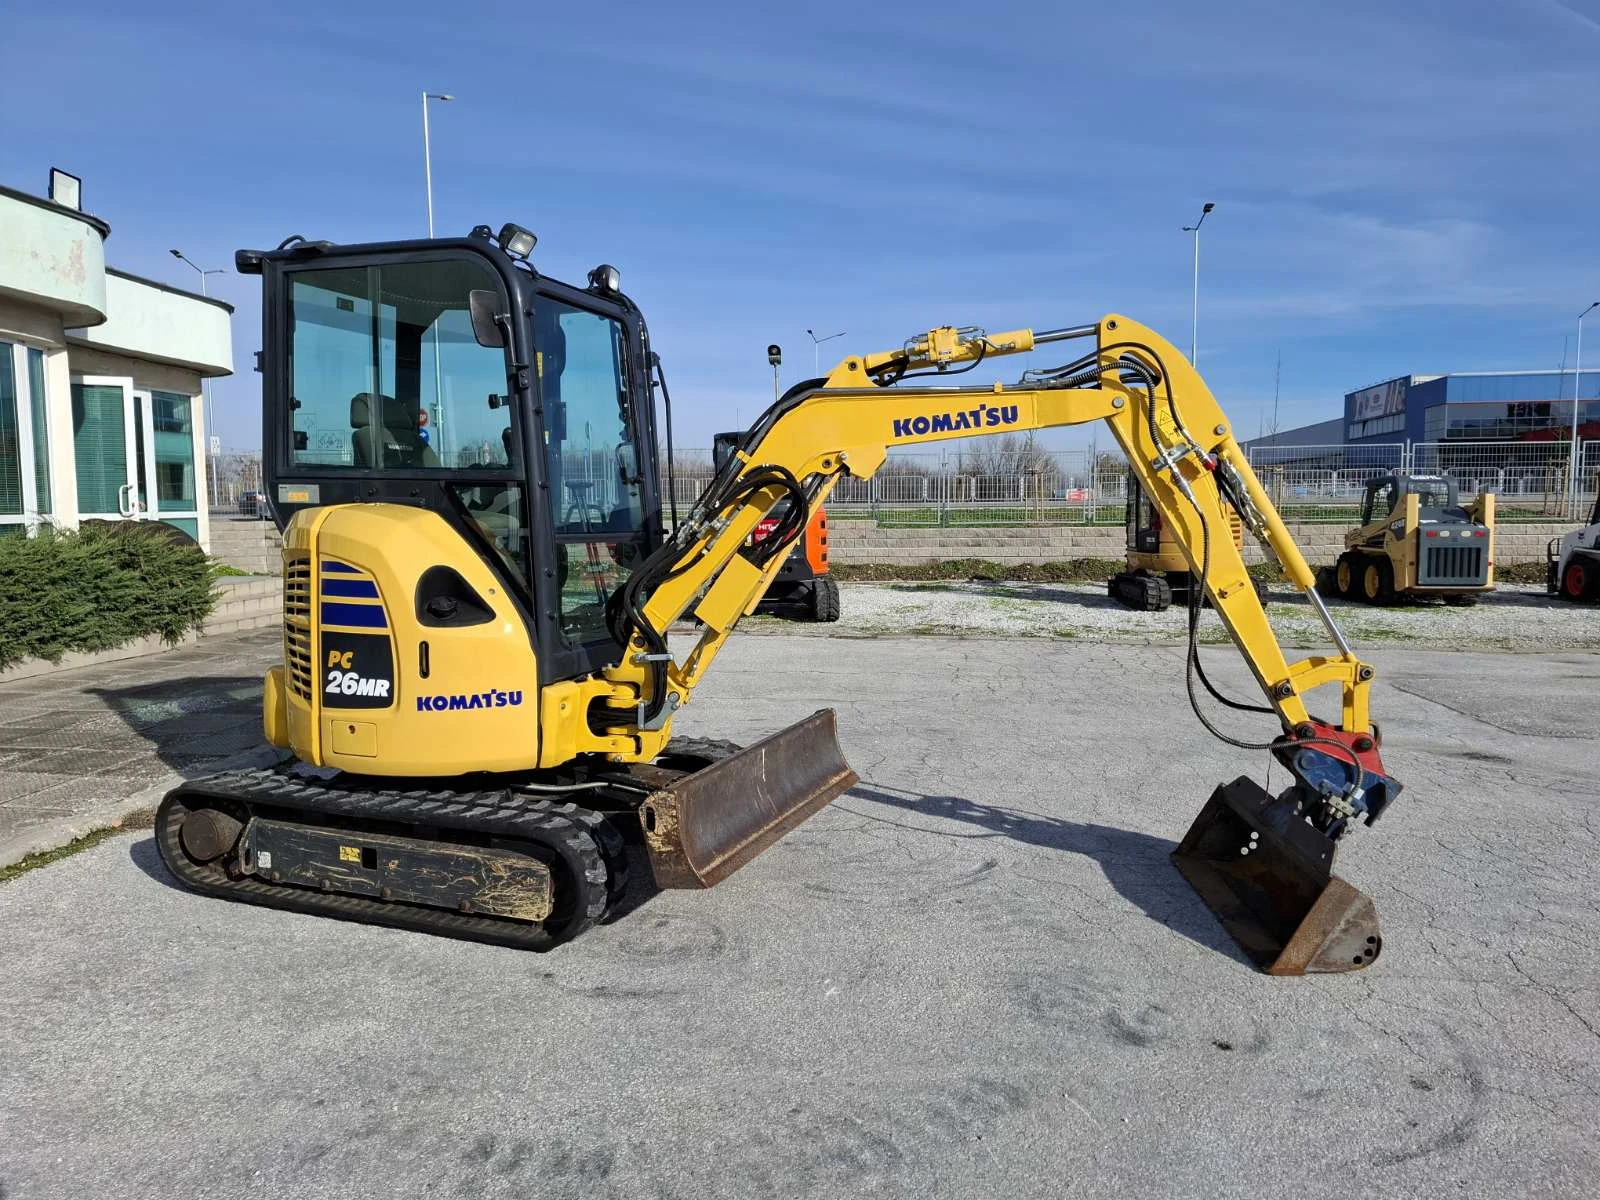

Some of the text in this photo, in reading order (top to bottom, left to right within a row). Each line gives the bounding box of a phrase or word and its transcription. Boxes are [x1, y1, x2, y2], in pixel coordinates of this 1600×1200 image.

[893, 404, 1018, 437] KOMATSU
[328, 650, 354, 669] PC
[325, 670, 390, 697] 26MR
[416, 689, 522, 712] KOMATSU
